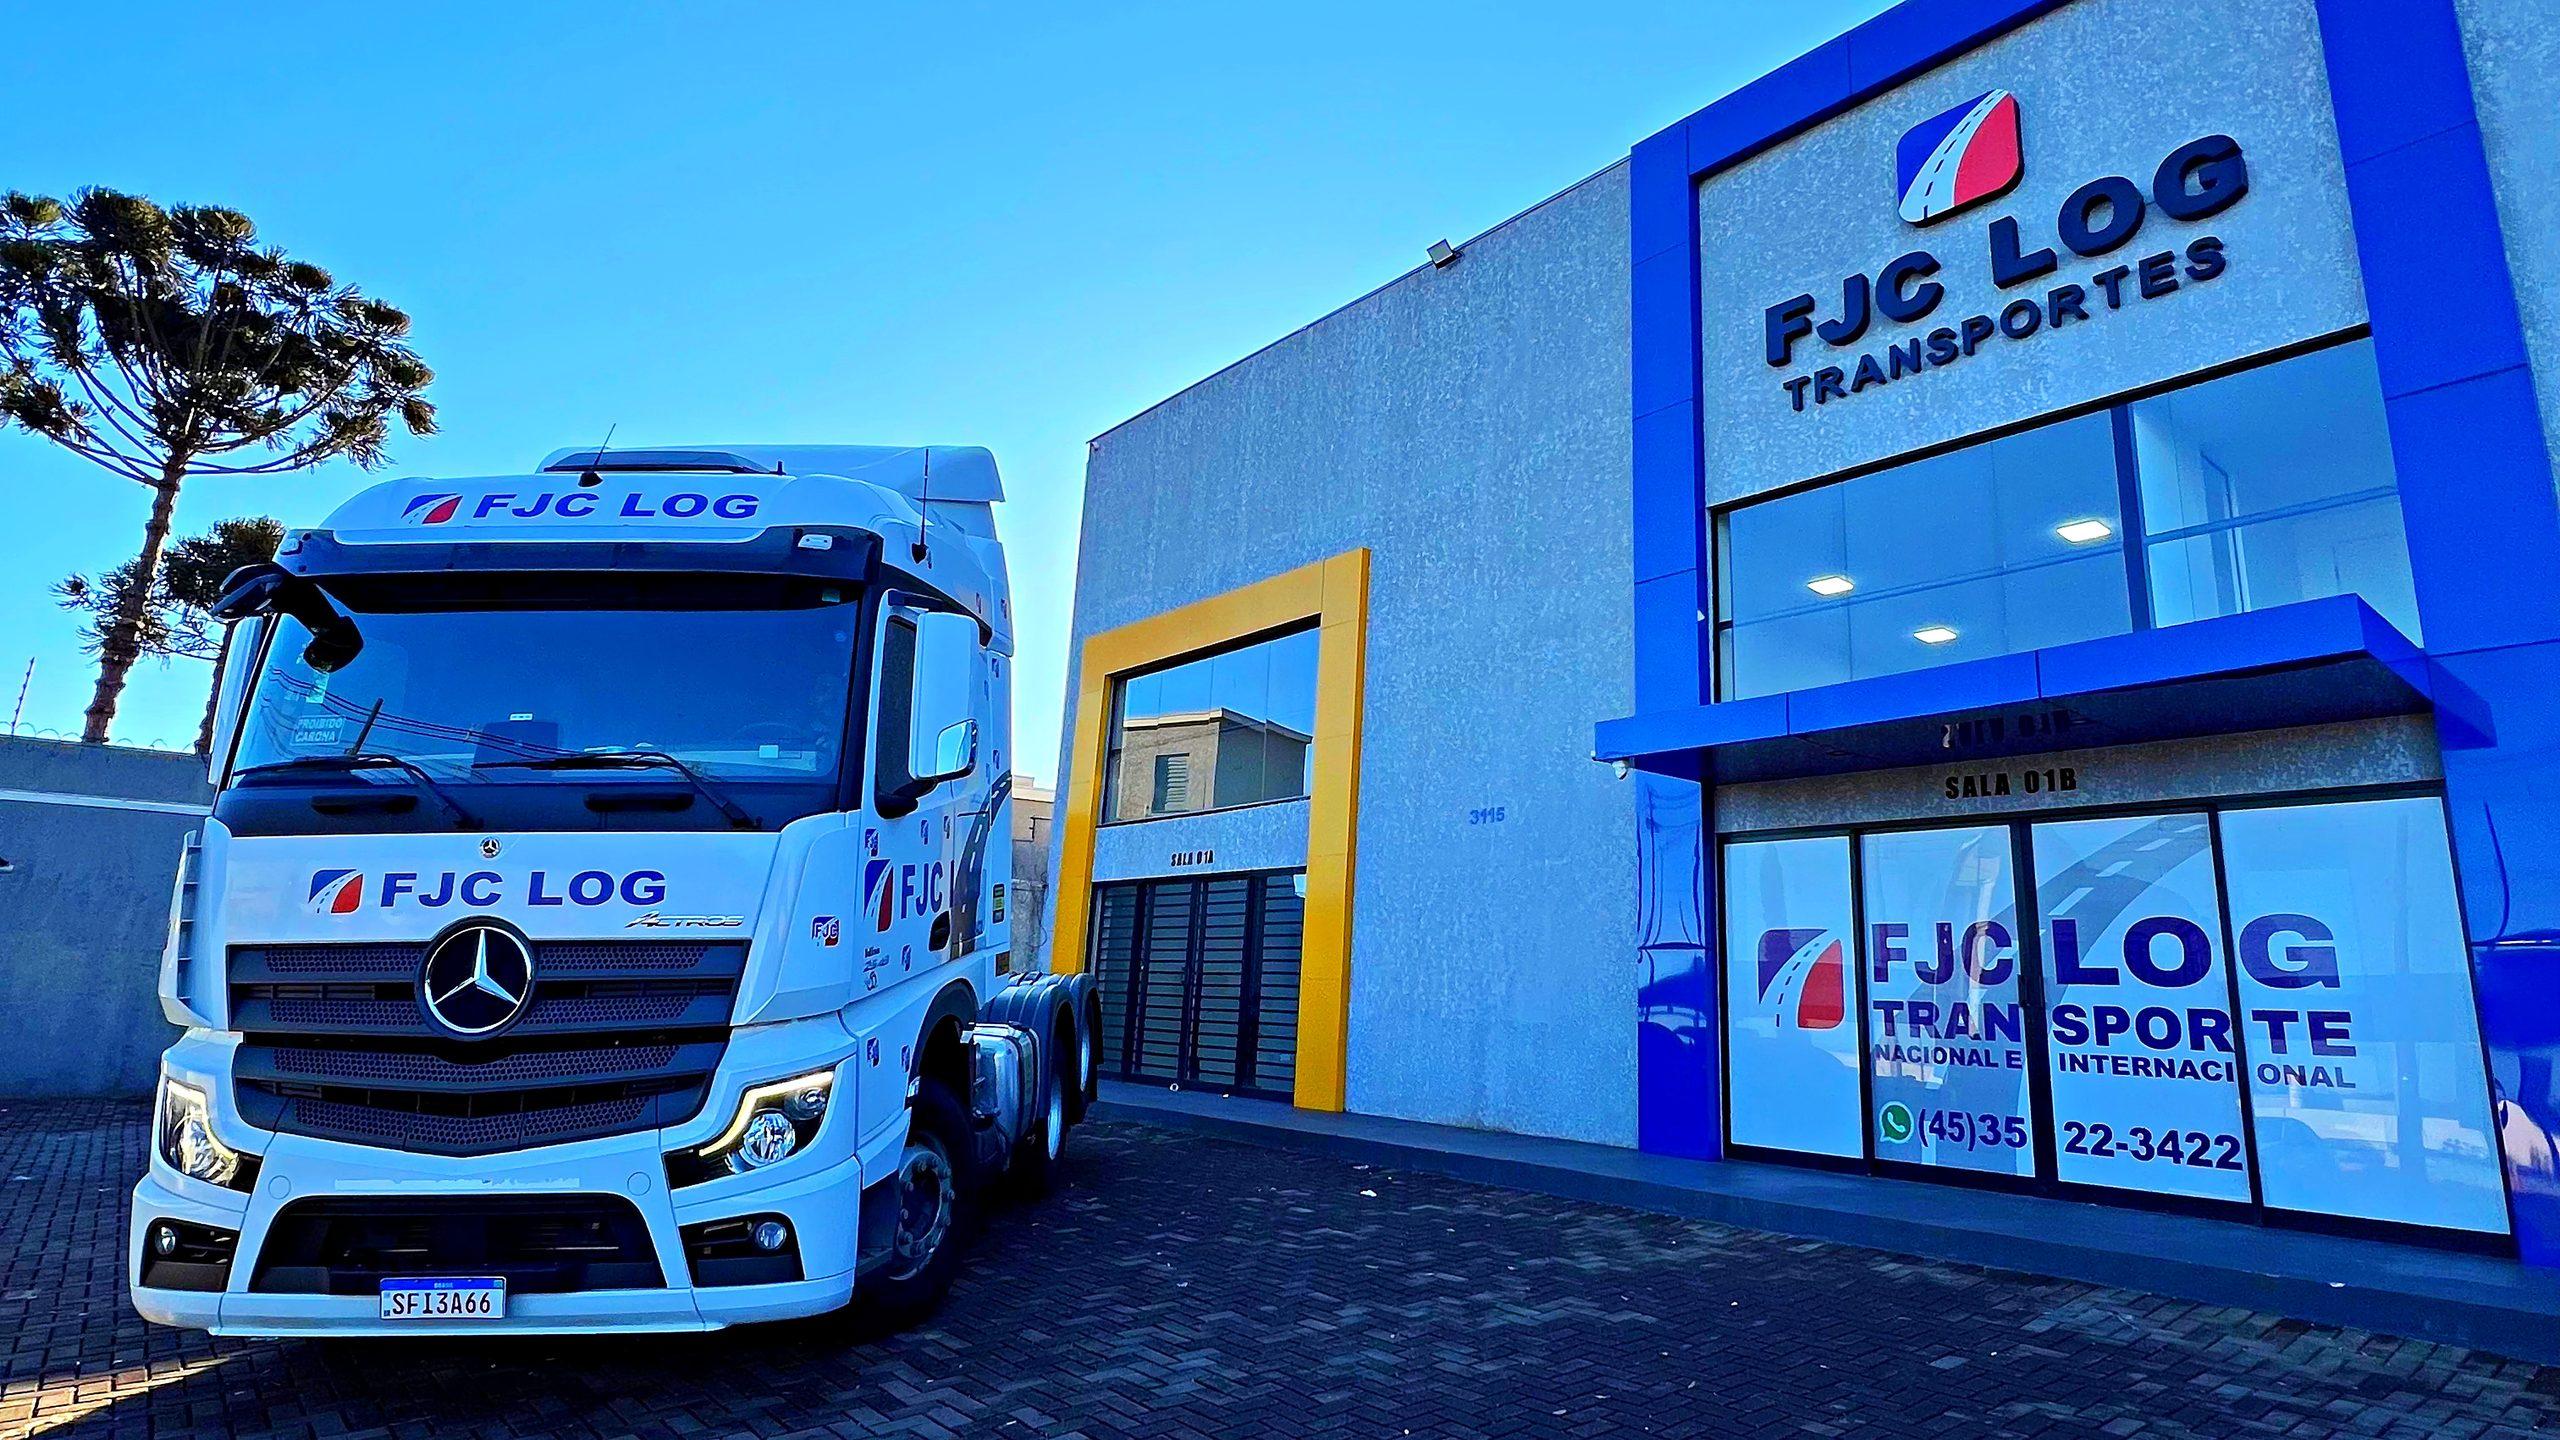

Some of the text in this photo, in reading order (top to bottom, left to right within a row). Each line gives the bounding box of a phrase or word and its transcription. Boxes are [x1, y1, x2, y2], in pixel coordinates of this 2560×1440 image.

[1765, 134, 2249, 367] FJC LOG
[1783, 236, 2227, 411] TRANSPORTES
[472, 493, 760, 519] FJC LOG
[1945, 767, 2077, 799] SALA 01B
[1469, 806, 1505, 825] 3115
[1171, 851, 1193, 867] SALA
[380, 870, 667, 907] FJC LOG
[901, 861, 944, 919] FJC
[814, 922, 839, 938] FJC
[1871, 914, 2341, 989] FJC LOG
[1875, 1044, 1998, 1069] NACIONAL
[2006, 1049, 2022, 1069] E
[392, 1291, 491, 1315] SFI3A66
